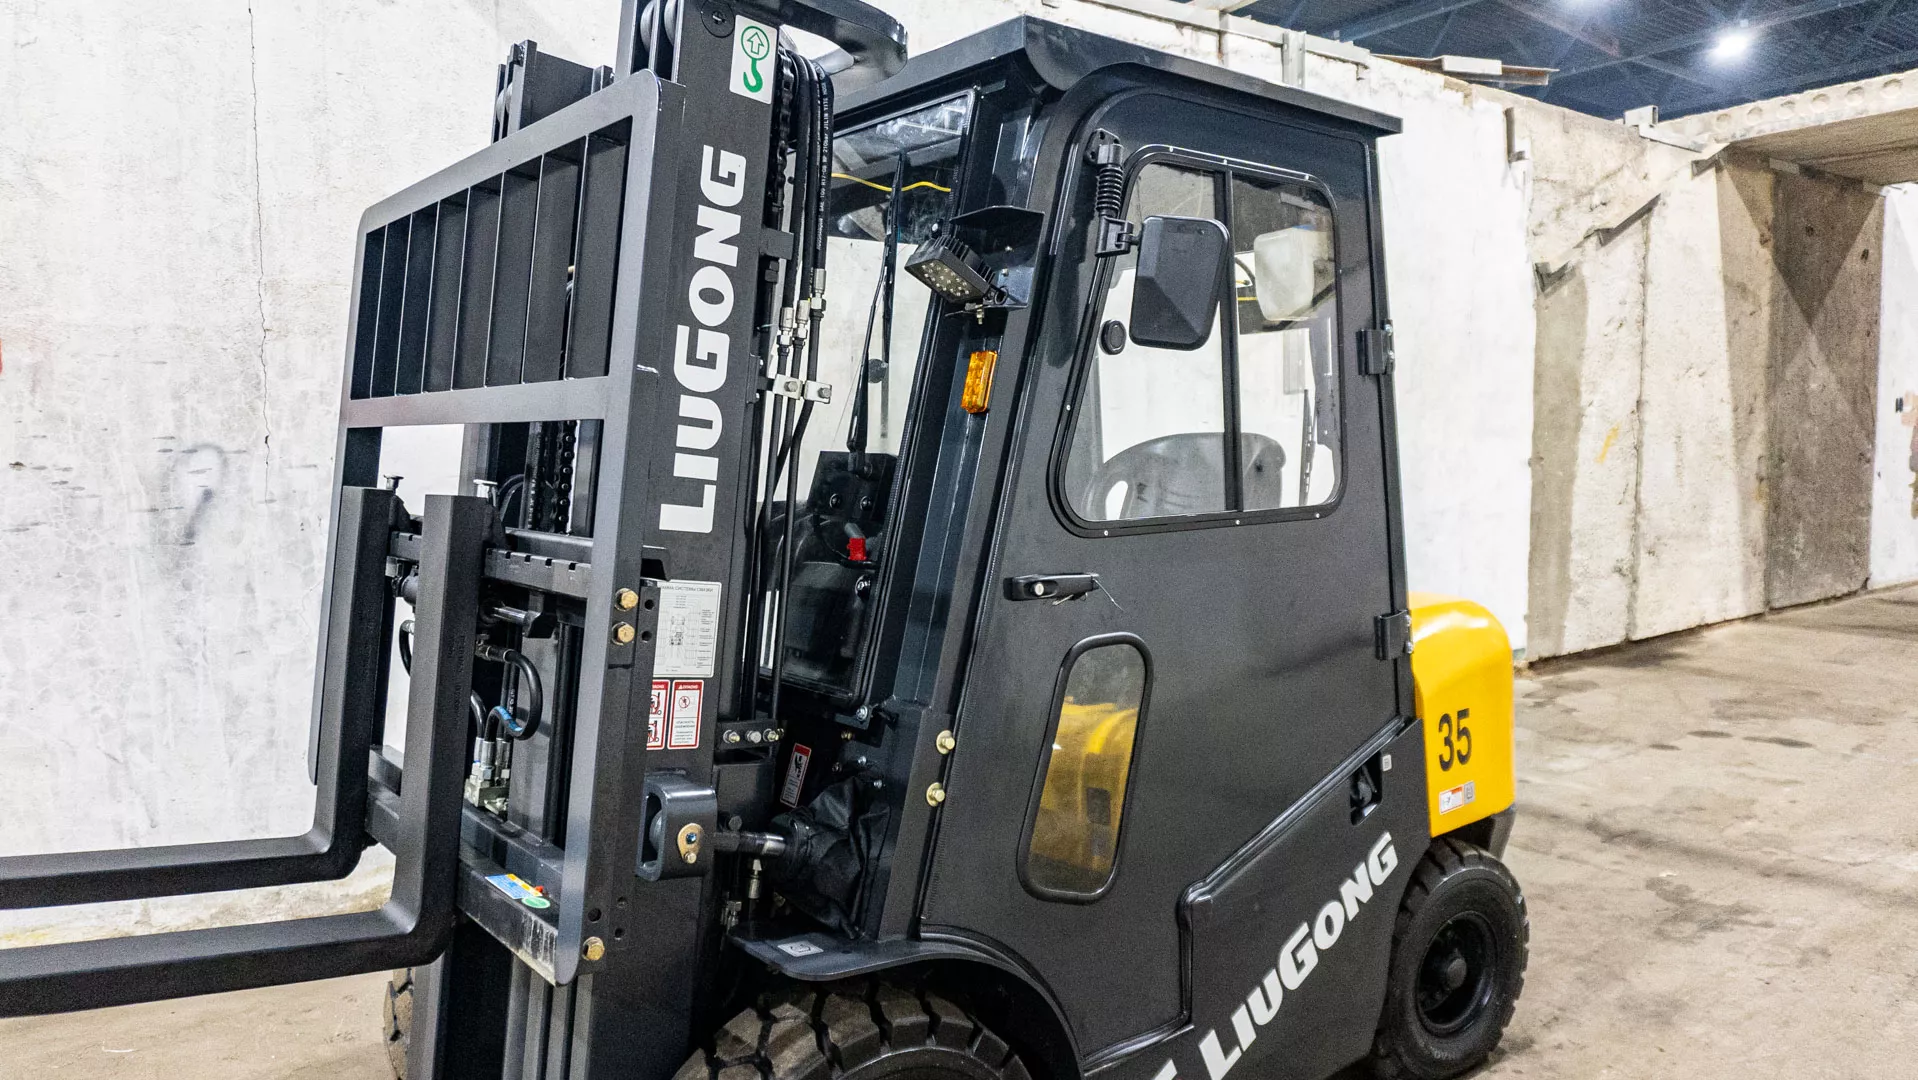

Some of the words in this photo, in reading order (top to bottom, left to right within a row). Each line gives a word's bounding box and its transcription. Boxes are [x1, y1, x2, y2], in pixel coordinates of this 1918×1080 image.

[659, 144, 747, 534] LIUGONG
[1438, 707, 1473, 772] 35
[1199, 831, 1399, 1080] LIUGONG
